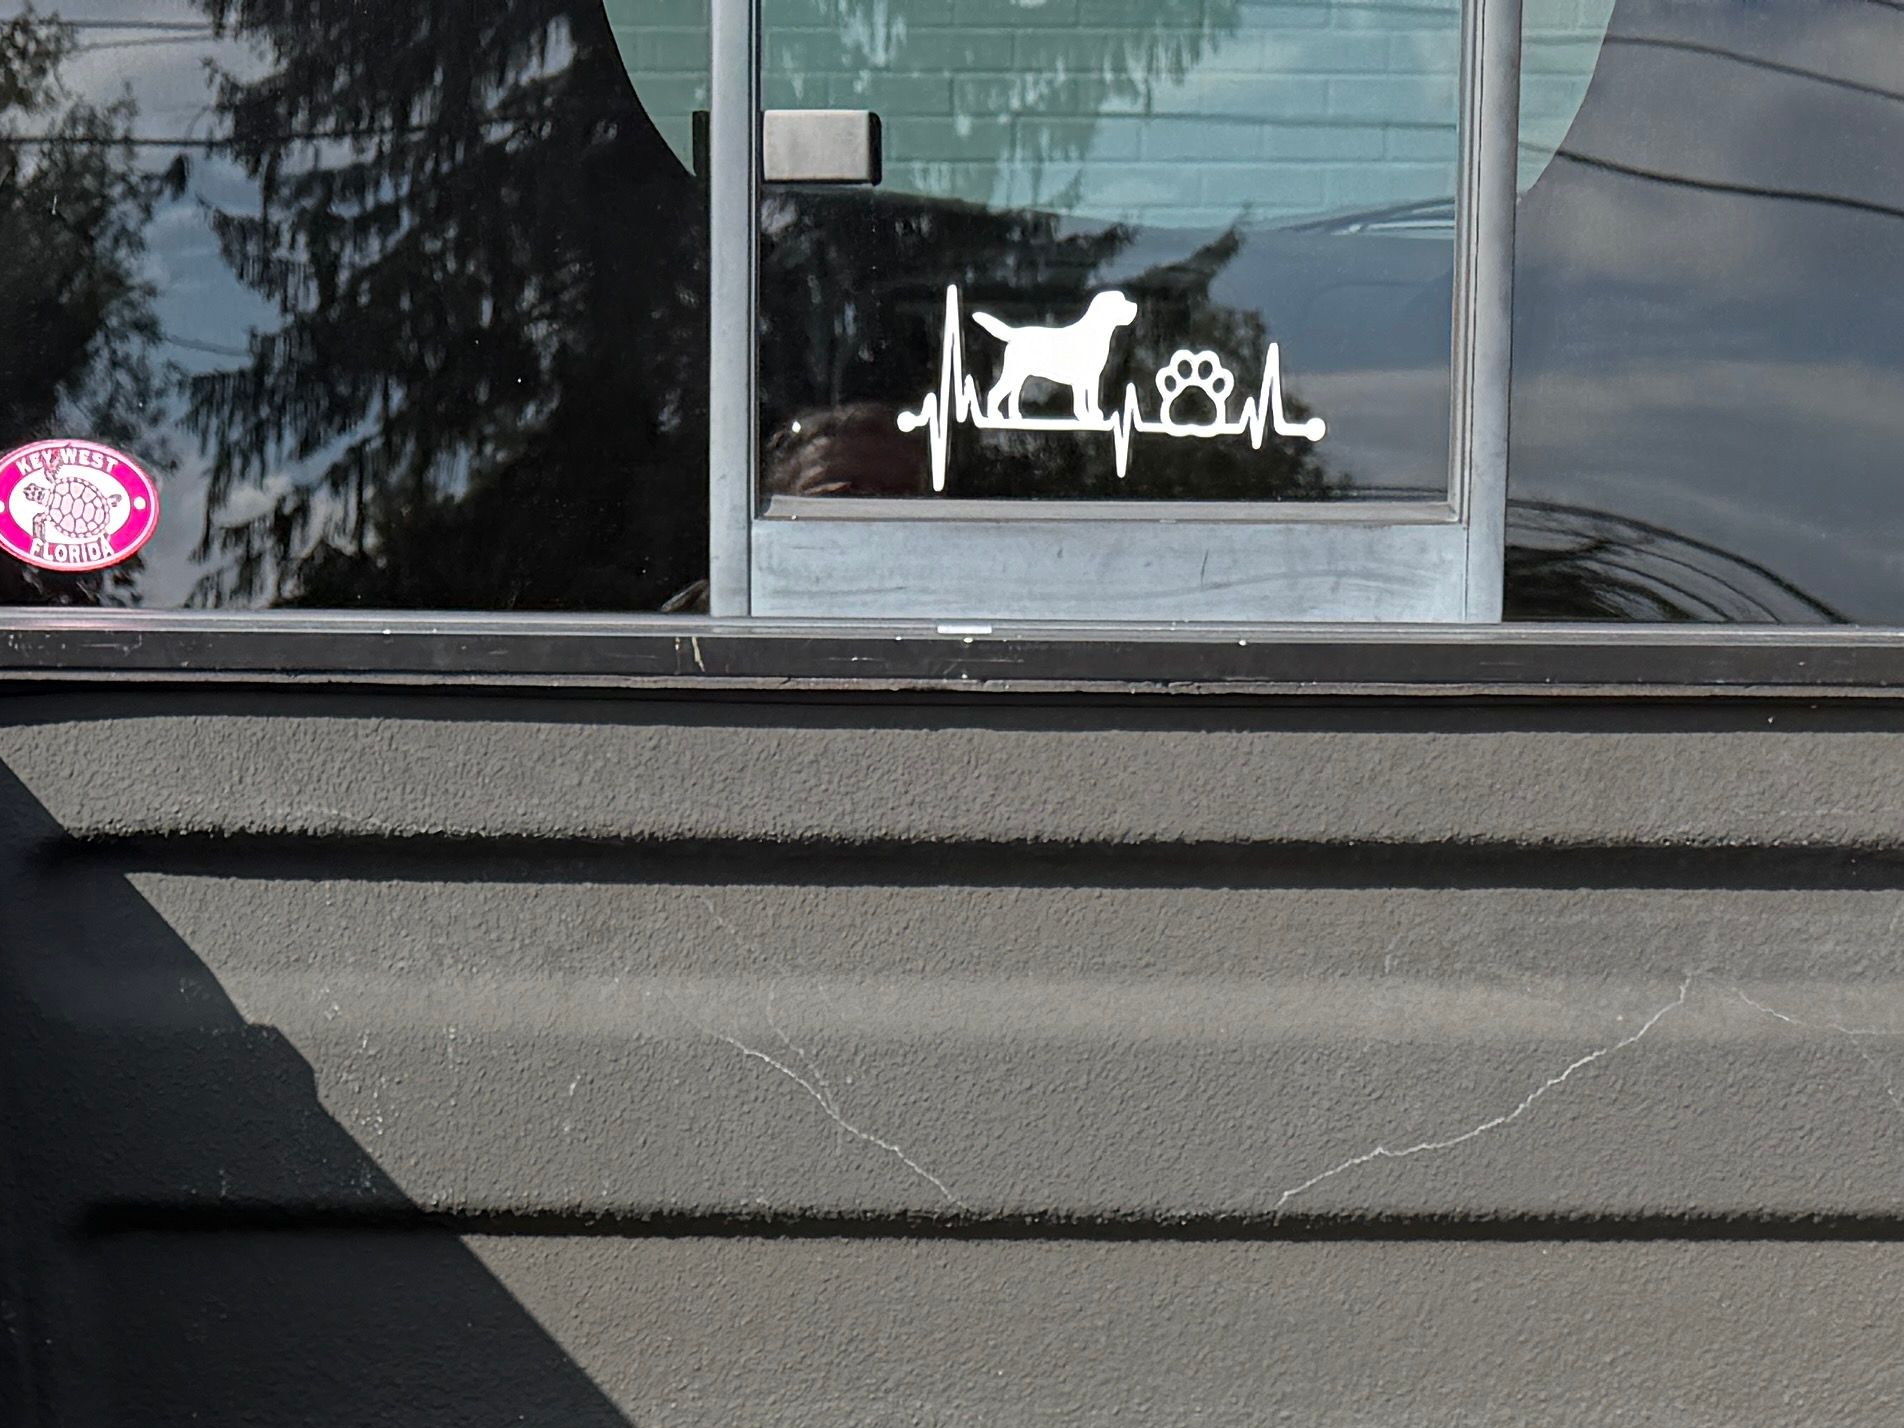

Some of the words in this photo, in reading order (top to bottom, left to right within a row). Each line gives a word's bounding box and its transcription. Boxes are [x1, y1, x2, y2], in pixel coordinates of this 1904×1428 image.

[15, 448, 53, 476] KEY
[60, 447, 119, 474] WEST
[30, 538, 115, 563] FLORIDA
